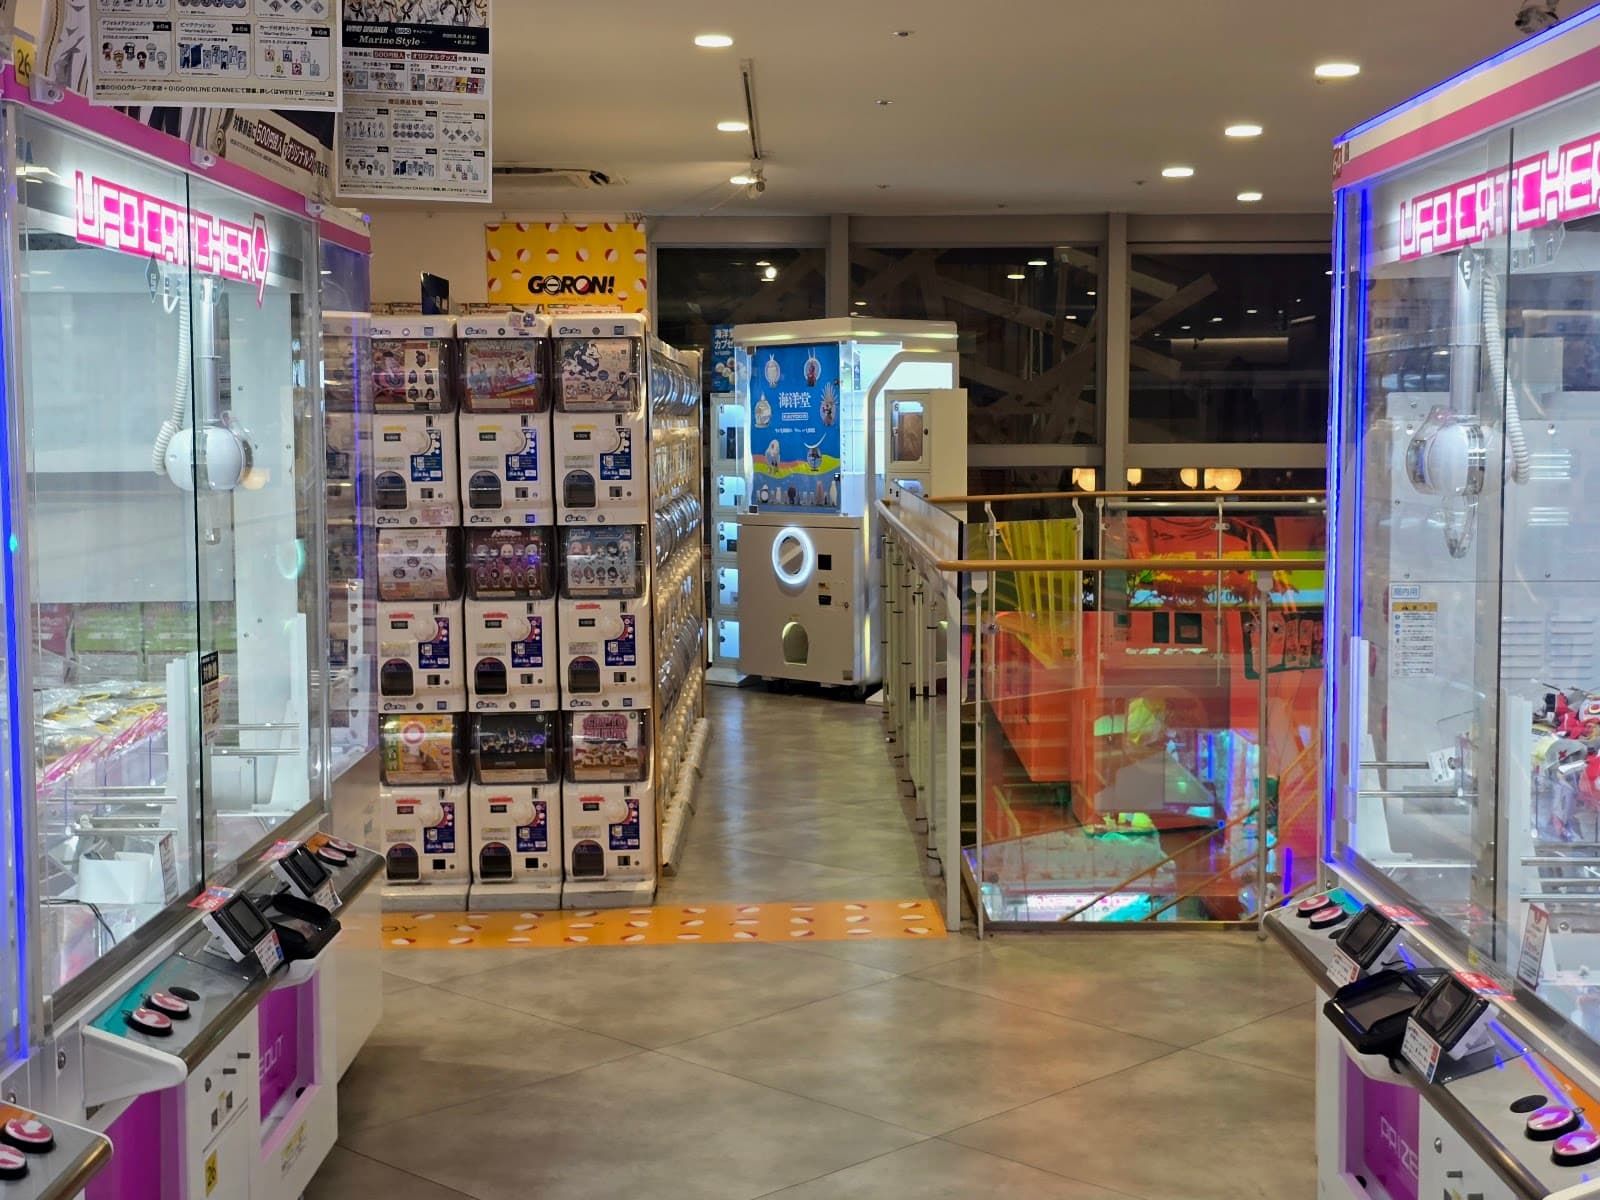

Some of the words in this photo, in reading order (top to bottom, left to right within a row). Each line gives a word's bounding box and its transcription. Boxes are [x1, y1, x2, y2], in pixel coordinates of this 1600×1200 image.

[359, 35, 395, 45] Marine
[395, 36, 421, 47] Style
[17, 49, 31, 79] 26
[527, 275, 615, 295] GORON!
[778, 391, 812, 408] 海洋堂
